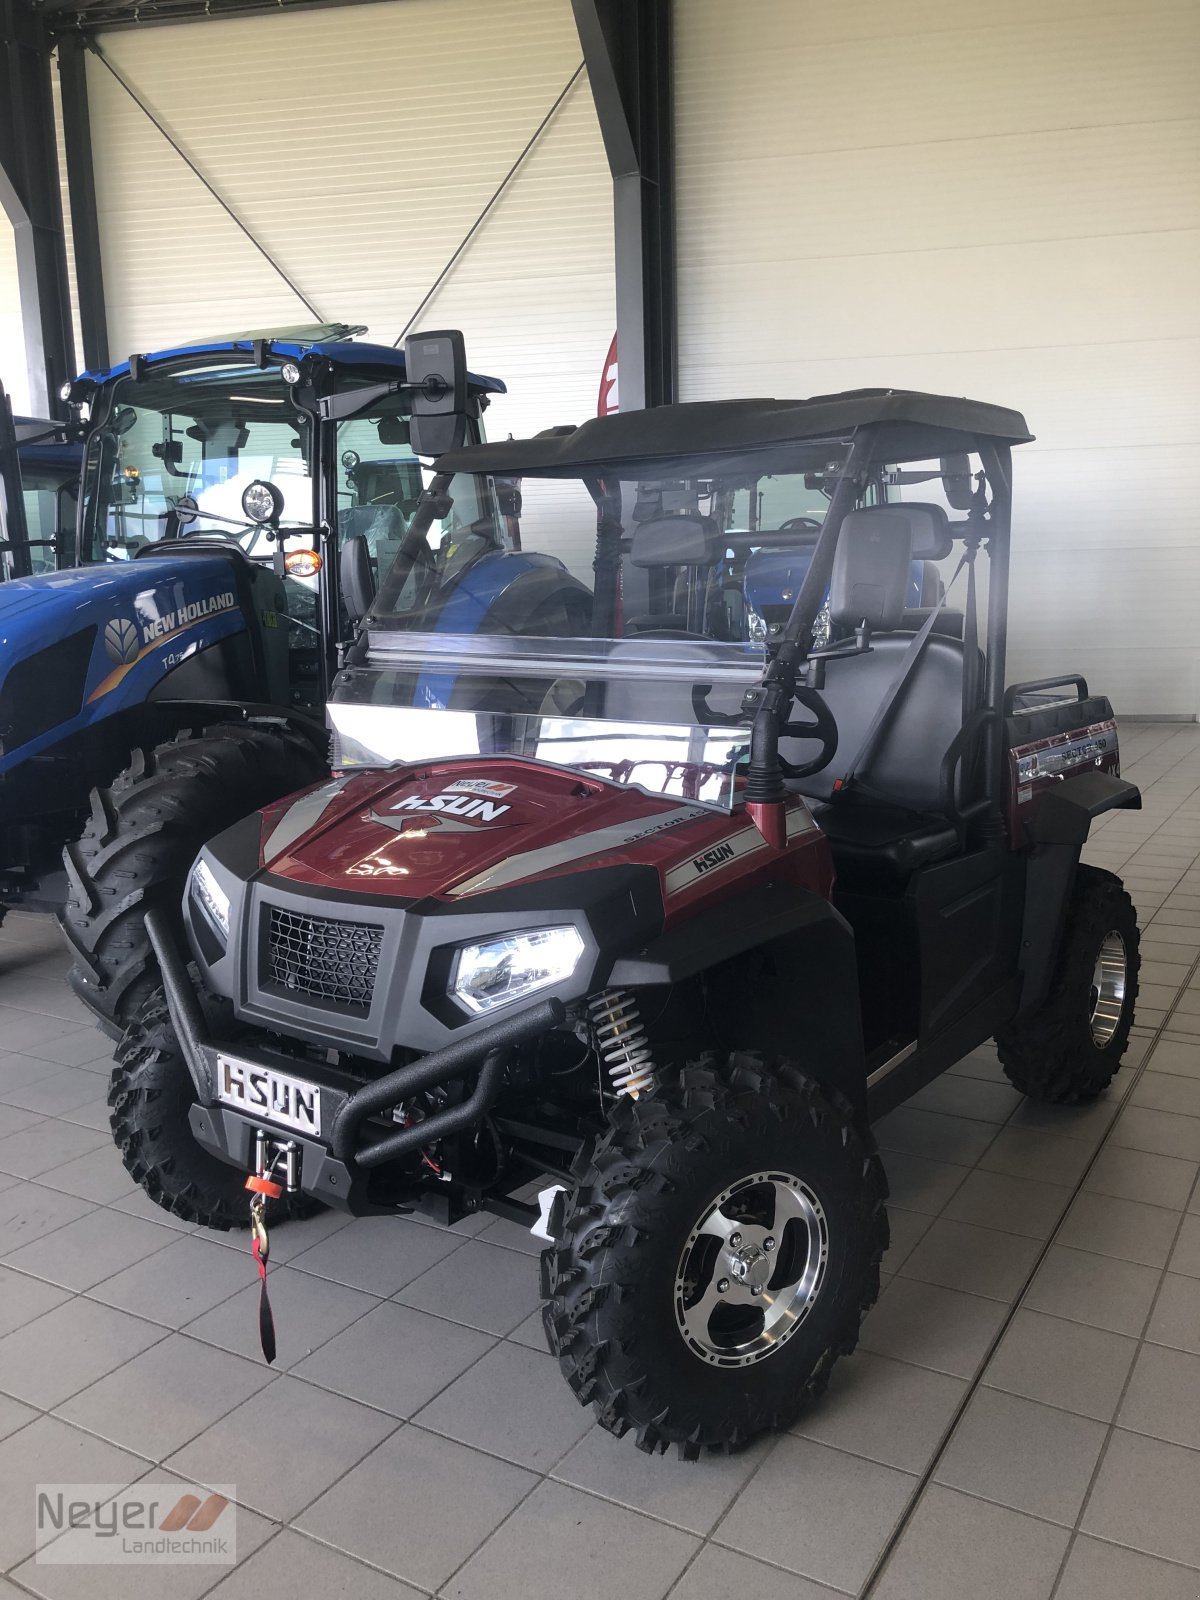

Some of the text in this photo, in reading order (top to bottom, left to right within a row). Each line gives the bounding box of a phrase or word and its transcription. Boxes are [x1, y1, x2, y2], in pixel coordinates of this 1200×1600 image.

[143, 592, 234, 644] NEW HOLLAND
[623, 817, 685, 843] SECTOR
